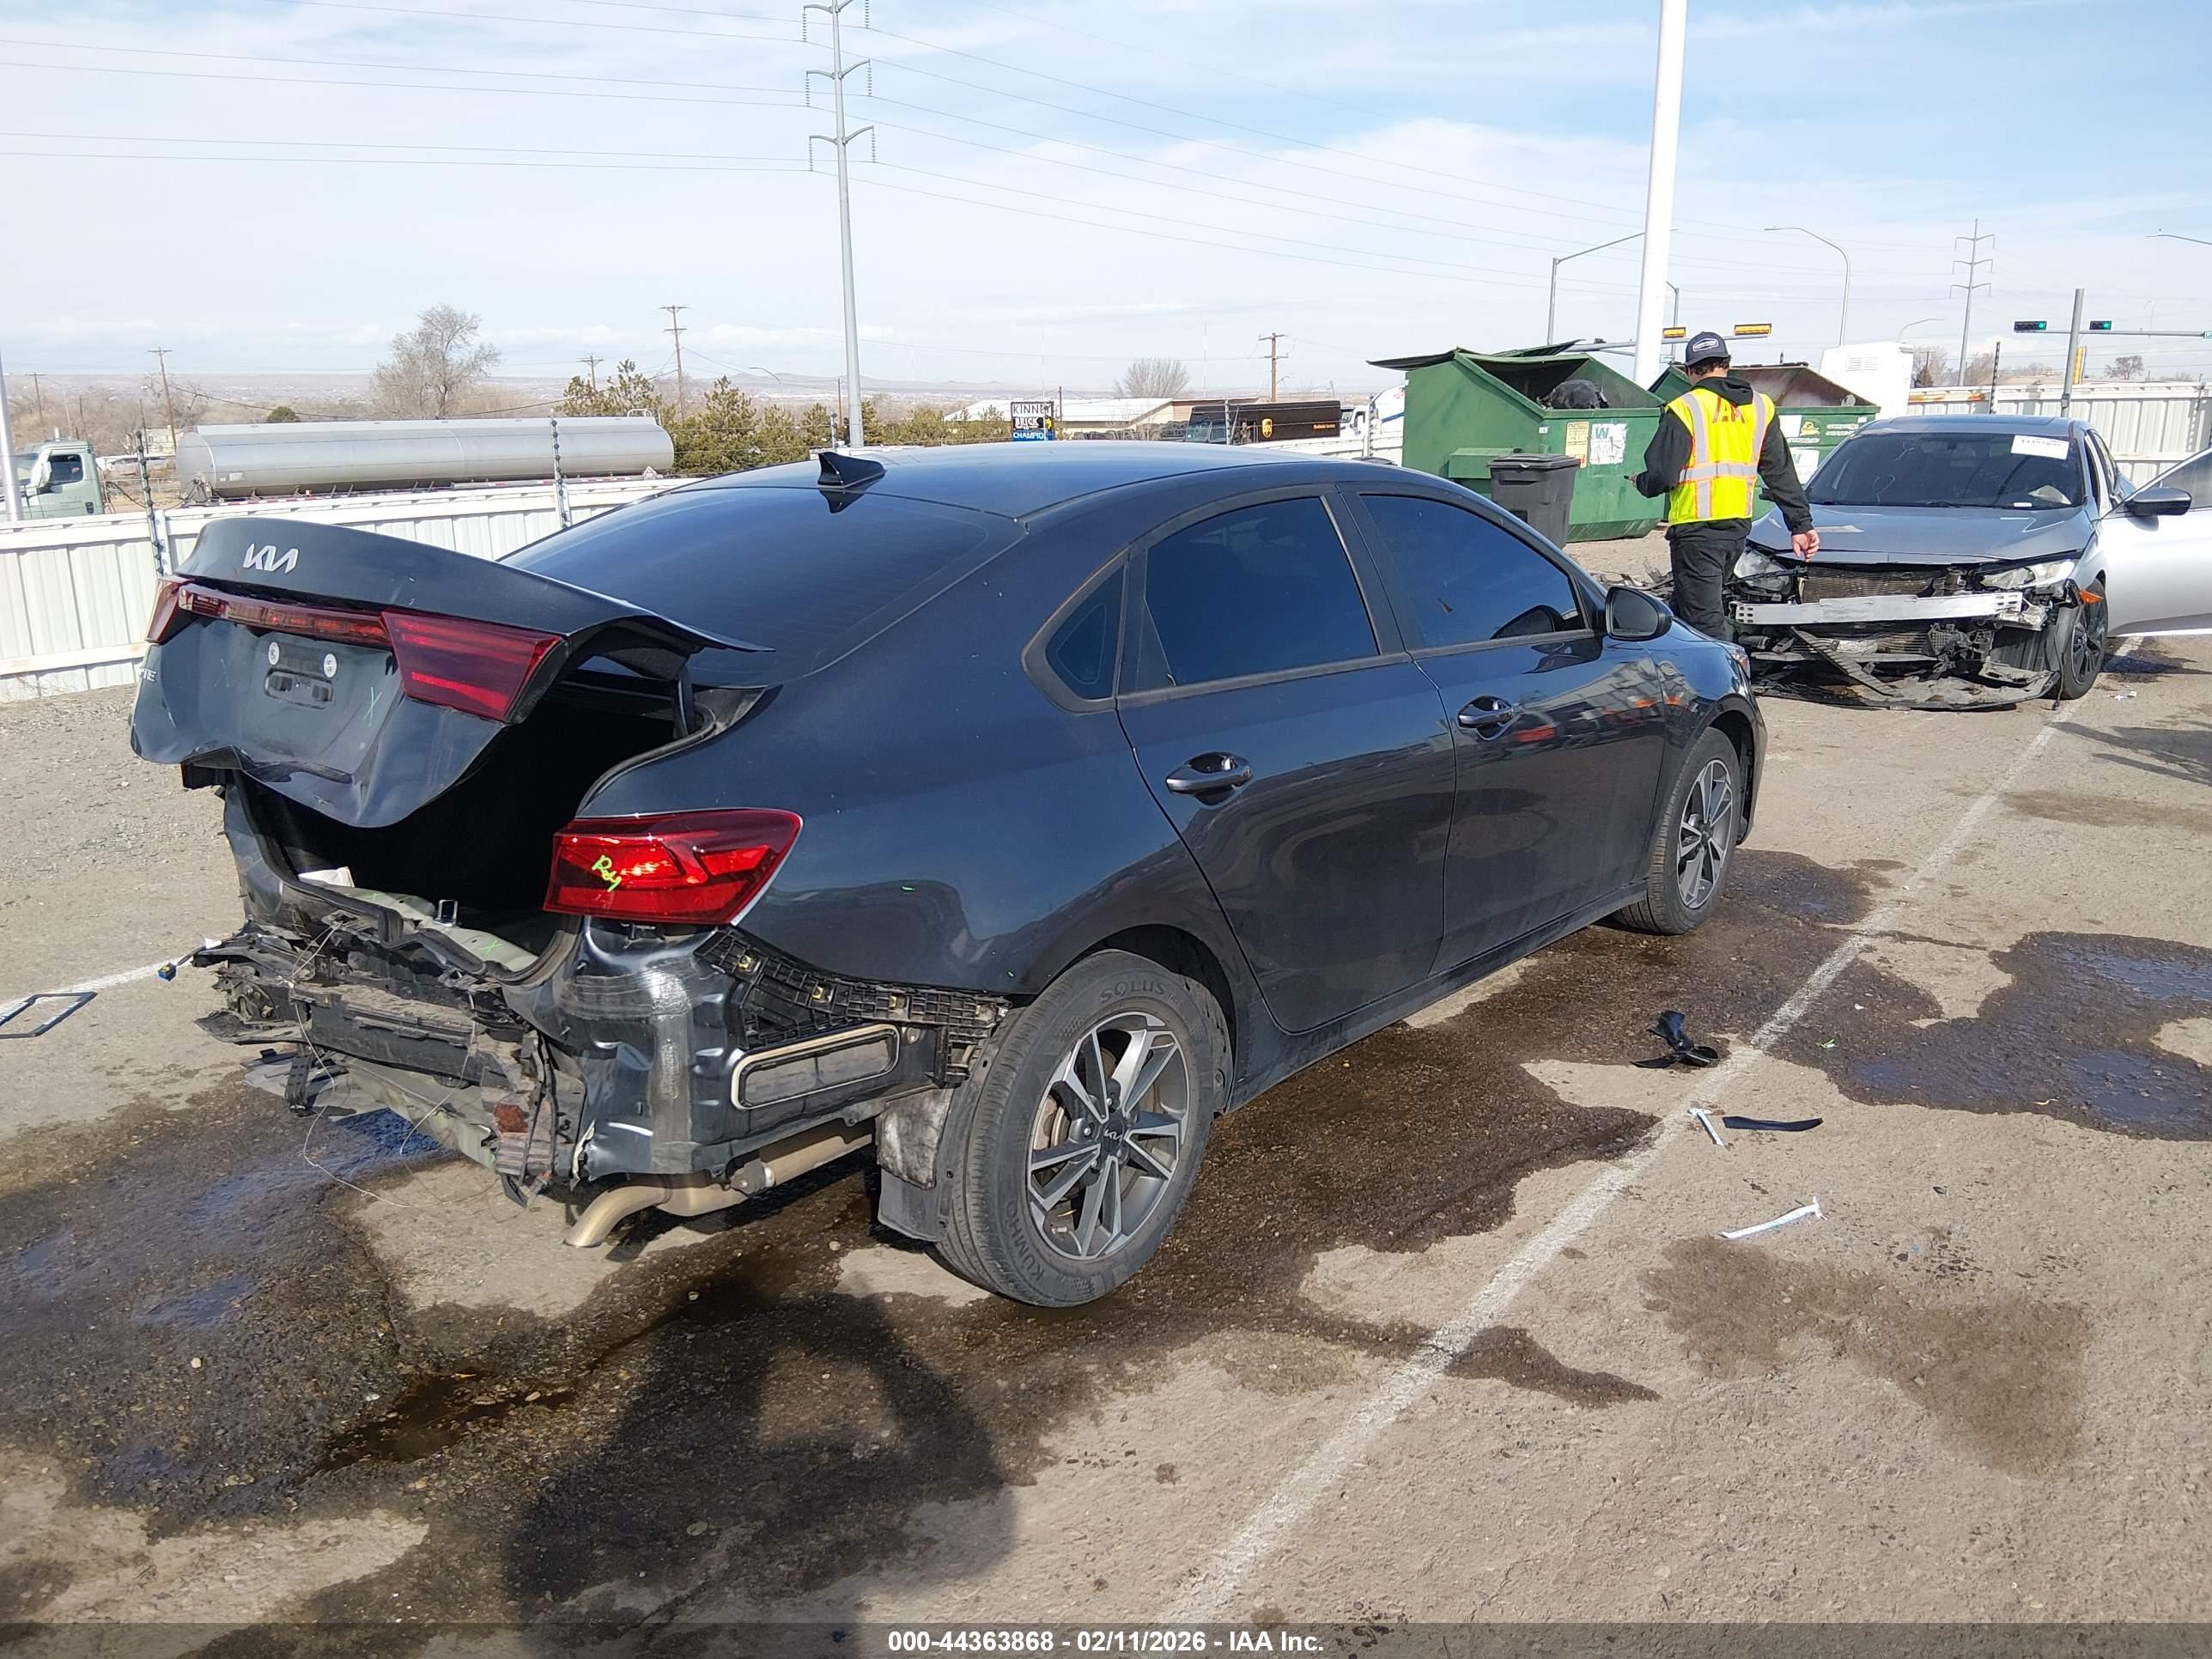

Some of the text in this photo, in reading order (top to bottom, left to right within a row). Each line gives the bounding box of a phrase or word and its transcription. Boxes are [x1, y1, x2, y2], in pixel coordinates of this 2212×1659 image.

[1013, 404, 1051, 414] KINNEY
[1016, 417, 1039, 427] BRICK
[243, 543, 299, 574] KIA
[1100, 980, 1166, 1003] SOLUS
[1006, 1200, 1045, 1282] KUMHO
